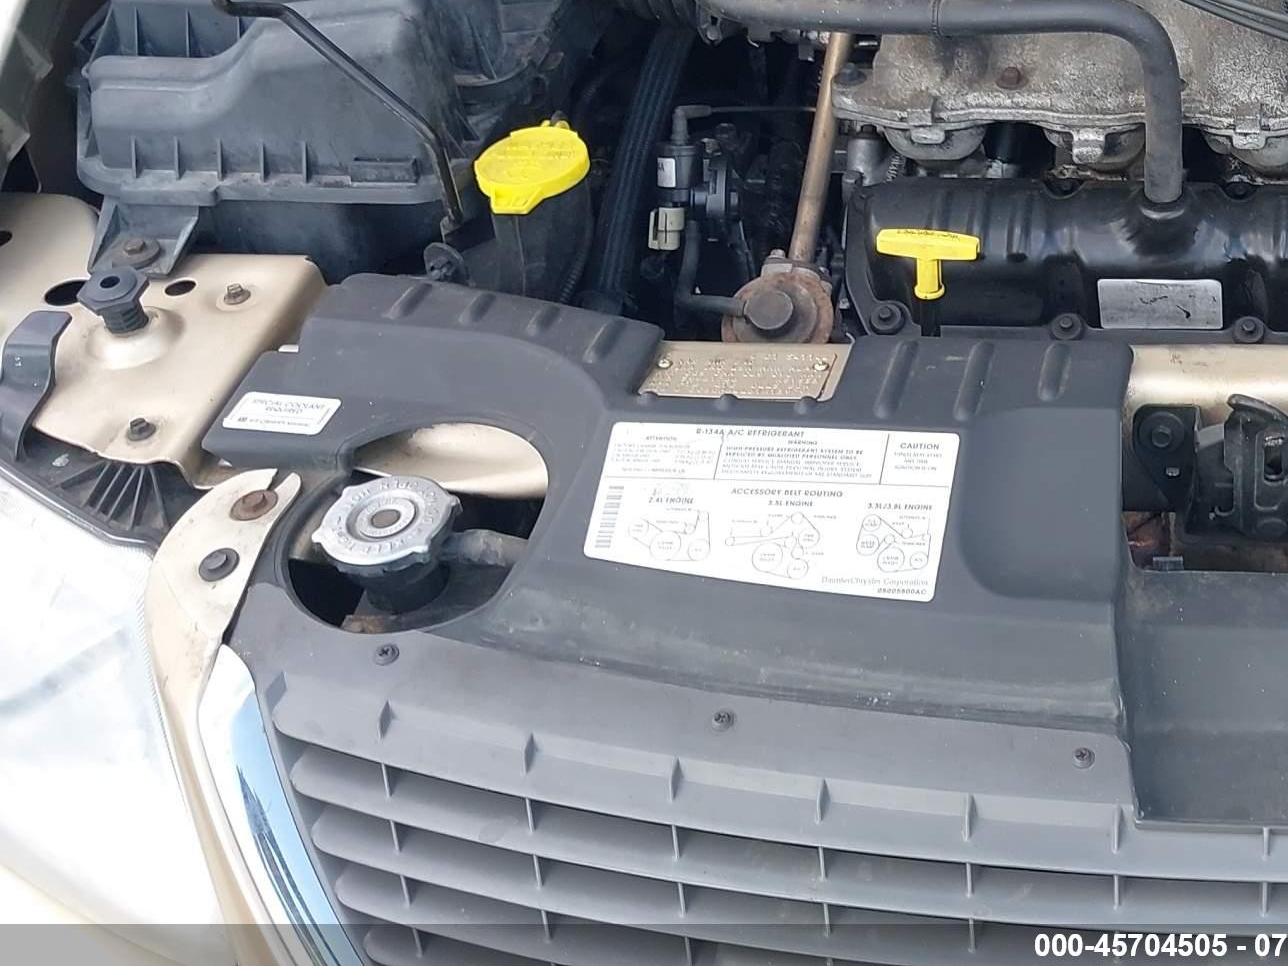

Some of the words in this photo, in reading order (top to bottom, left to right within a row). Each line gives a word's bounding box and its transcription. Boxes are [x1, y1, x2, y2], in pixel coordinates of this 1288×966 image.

[747, 429, 804, 437] REFRIGERANT
[900, 442, 940, 450] CAUTION
[731, 487, 781, 496] ACCESSORY
[804, 490, 843, 498] ROUTING
